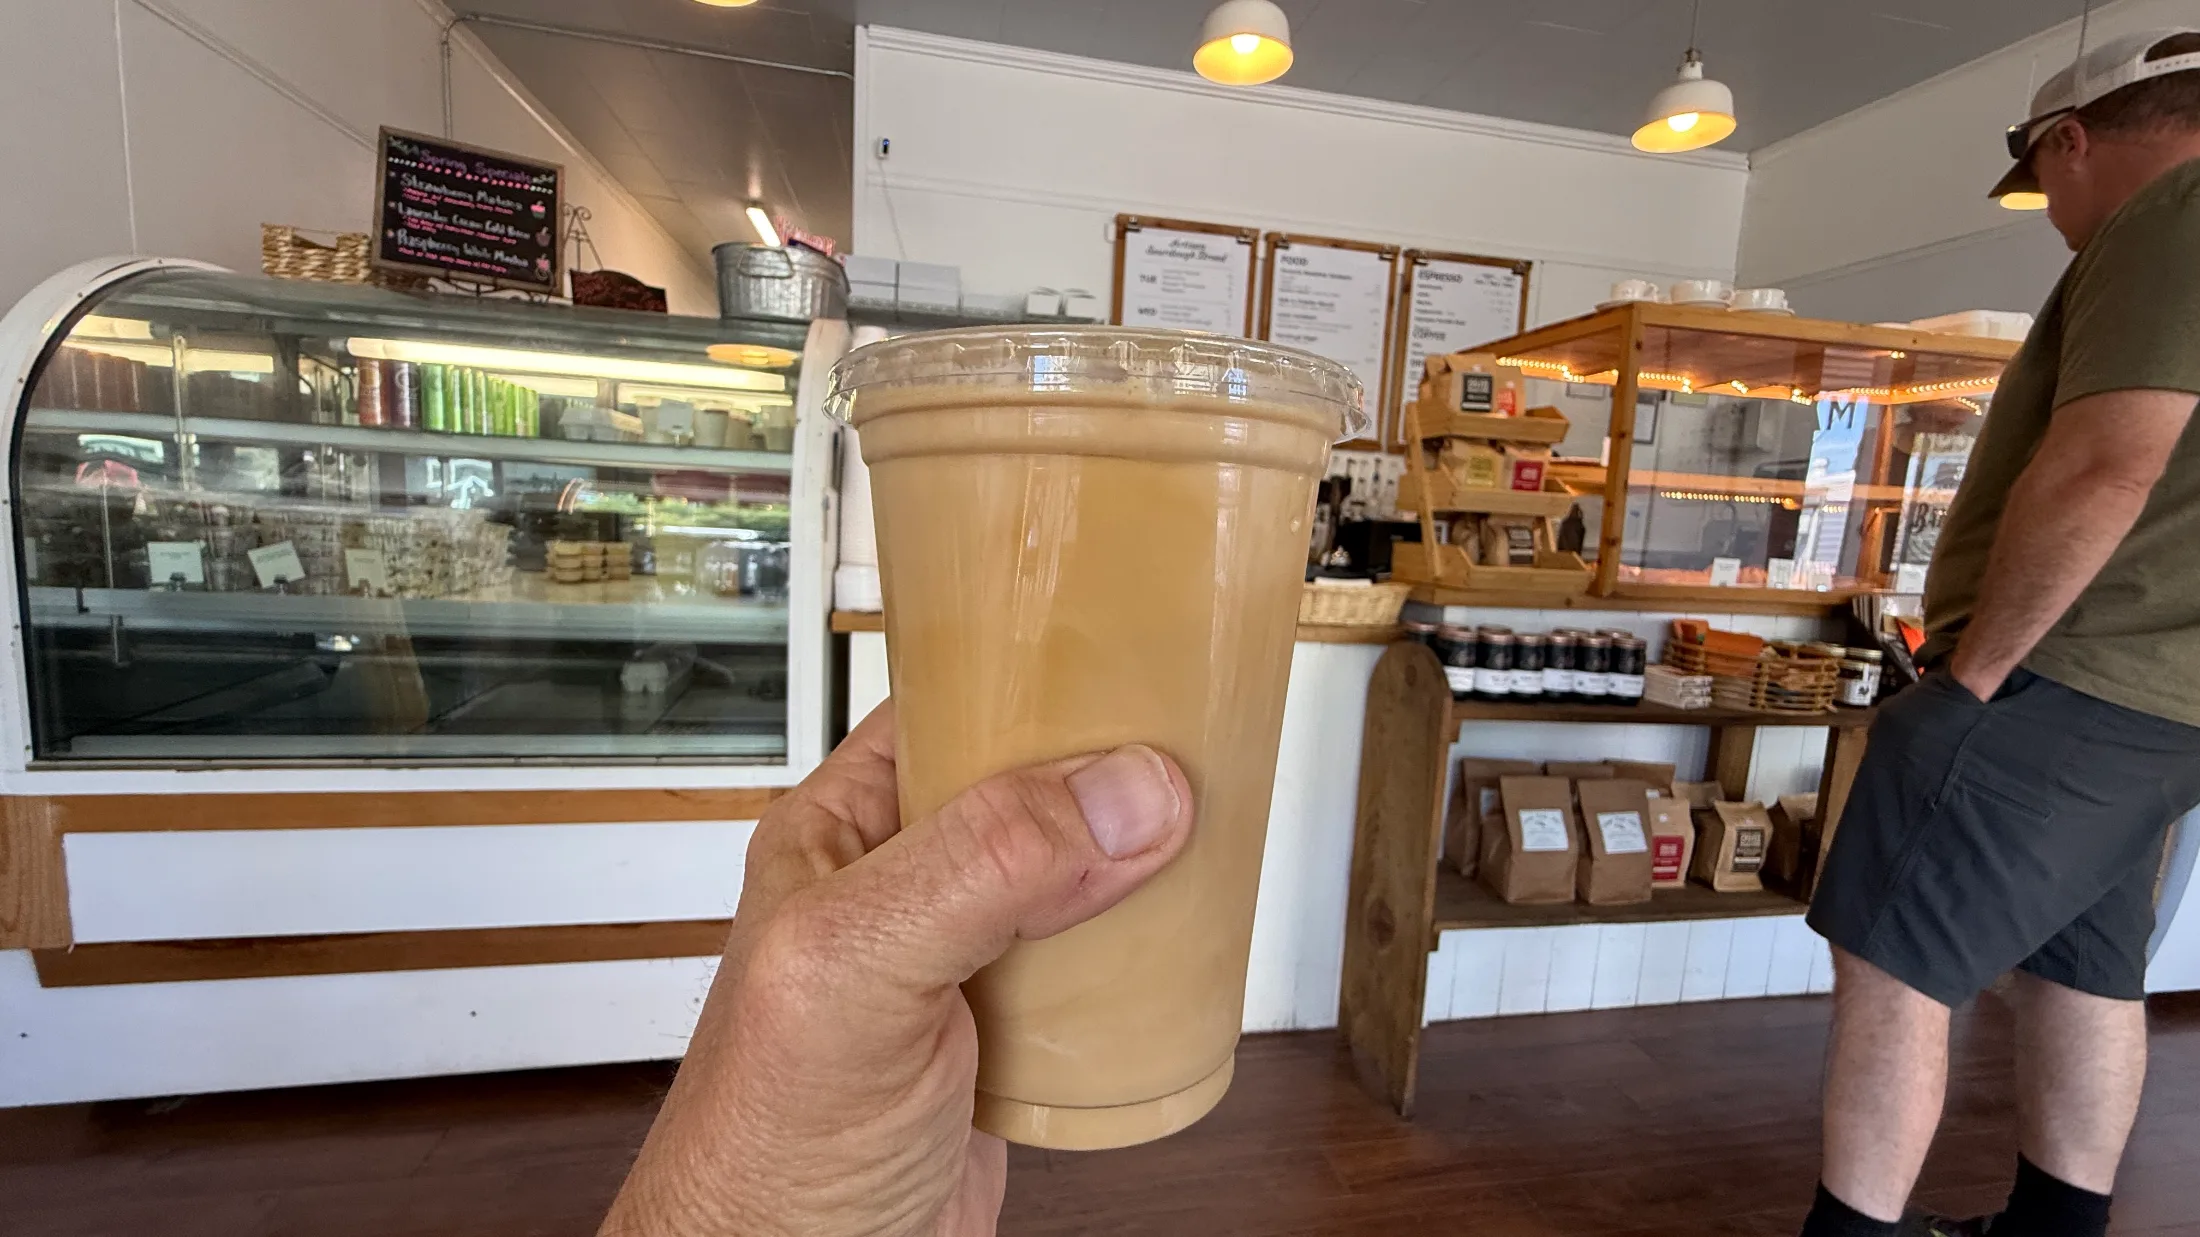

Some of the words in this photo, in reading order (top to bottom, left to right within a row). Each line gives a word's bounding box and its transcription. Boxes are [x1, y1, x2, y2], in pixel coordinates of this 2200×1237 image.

[400, 172, 474, 201] Strawberry
[485, 220, 505, 235] Cold
[397, 228, 460, 256] Raspberry
[1145, 245, 1196, 261] Sourdough
[1197, 251, 1228, 263] Bread
[1281, 255, 1308, 266] FOOD
[1418, 270, 1463, 284] ESPRESSO
